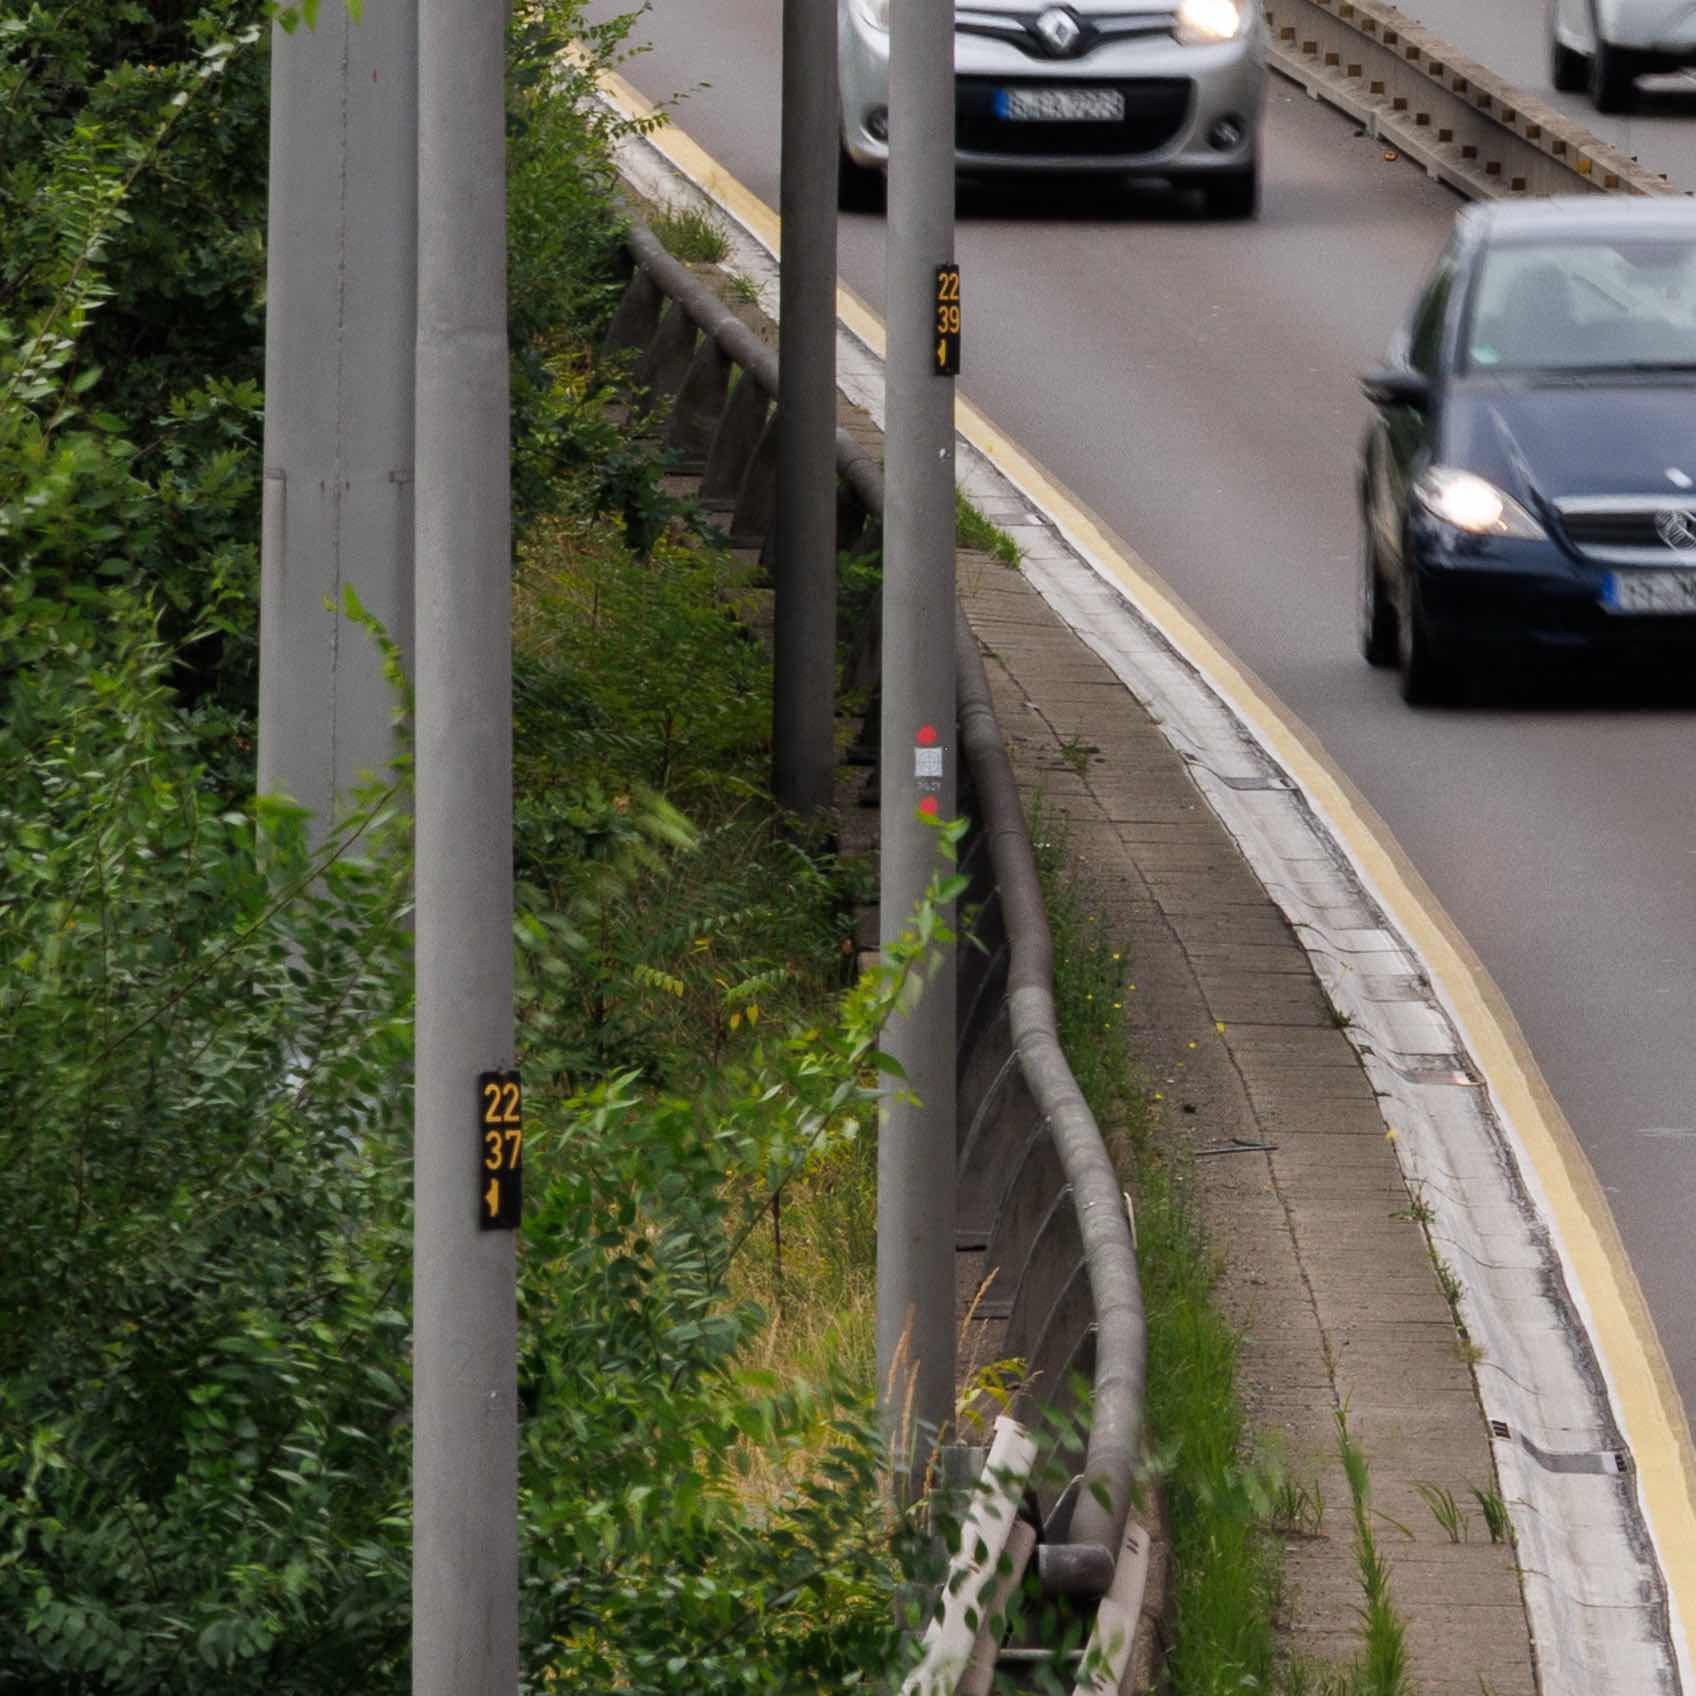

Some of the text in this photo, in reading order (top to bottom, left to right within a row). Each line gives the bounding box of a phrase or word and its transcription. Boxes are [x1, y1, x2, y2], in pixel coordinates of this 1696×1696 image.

[938, 272, 960, 301] 22
[937, 305, 960, 334] 39
[483, 1082, 521, 1123] 22
[484, 1129, 522, 1171] 37
